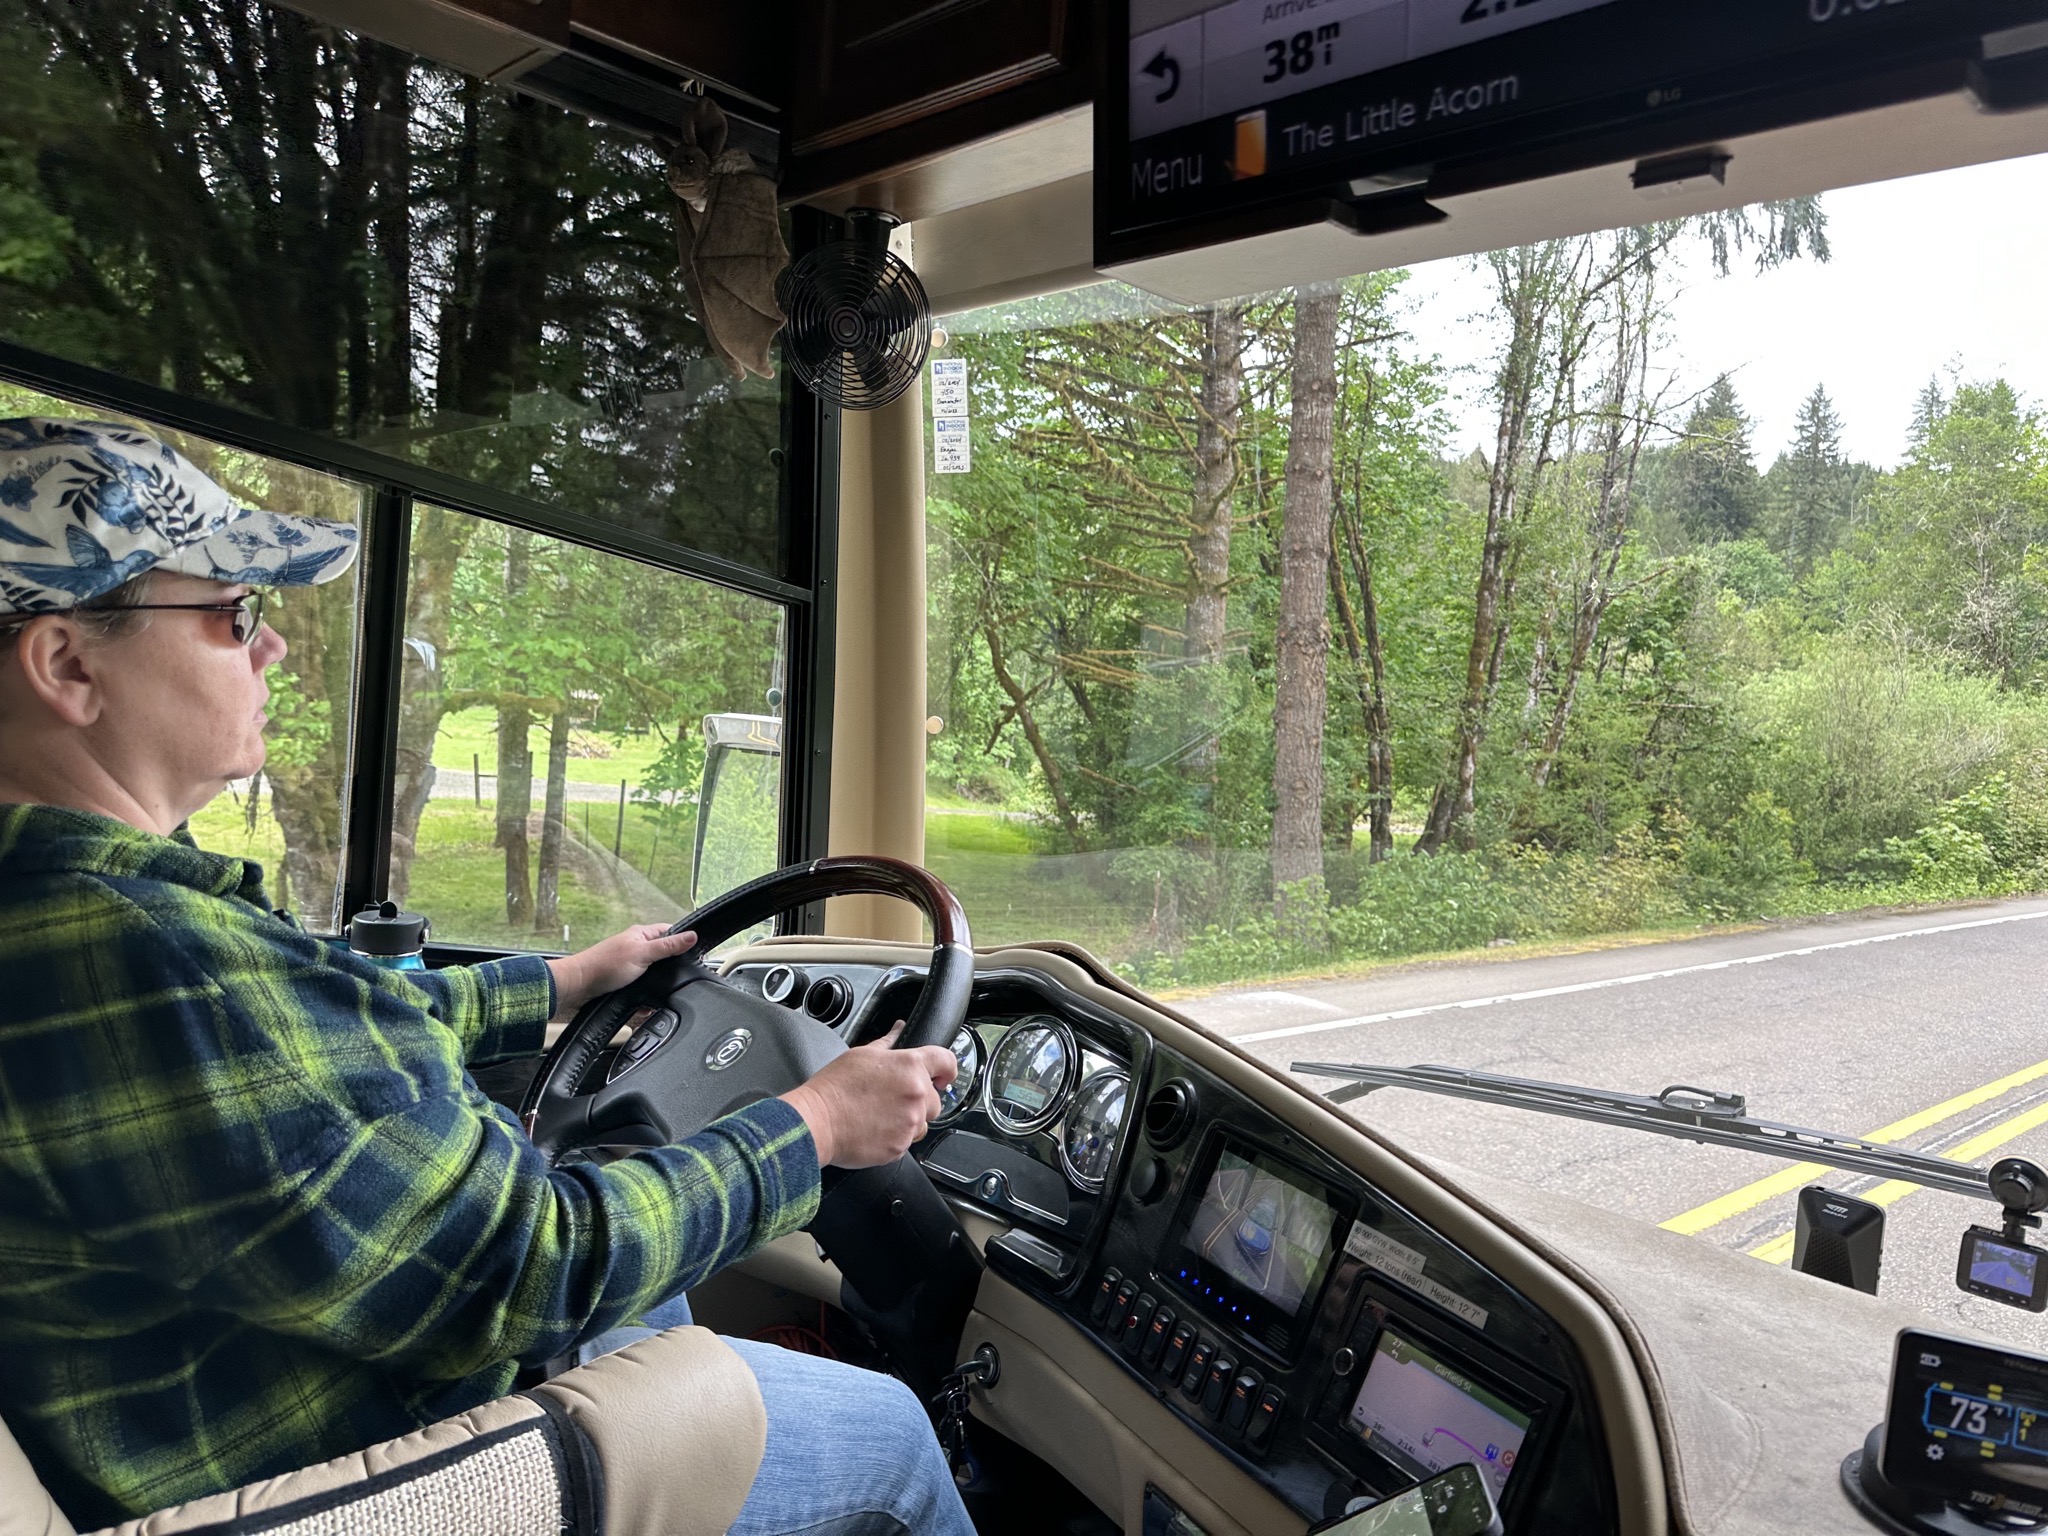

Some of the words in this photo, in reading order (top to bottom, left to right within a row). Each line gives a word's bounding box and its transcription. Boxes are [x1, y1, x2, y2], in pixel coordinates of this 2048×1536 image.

[1283, 123, 1334, 157] The
[1345, 98, 1416, 142] Little
[1426, 74, 1519, 122] Acorn
[1131, 152, 1202, 199] Menu
[1375, 1255, 1385, 1267] 12
[1384, 1261, 1400, 1276] tons
[1401, 1270, 1423, 1289] (rear)
[1430, 1286, 1456, 1308] Height:
[1434, 1363, 1463, 1387] Garfield
[1950, 1396, 1989, 1435] 73
